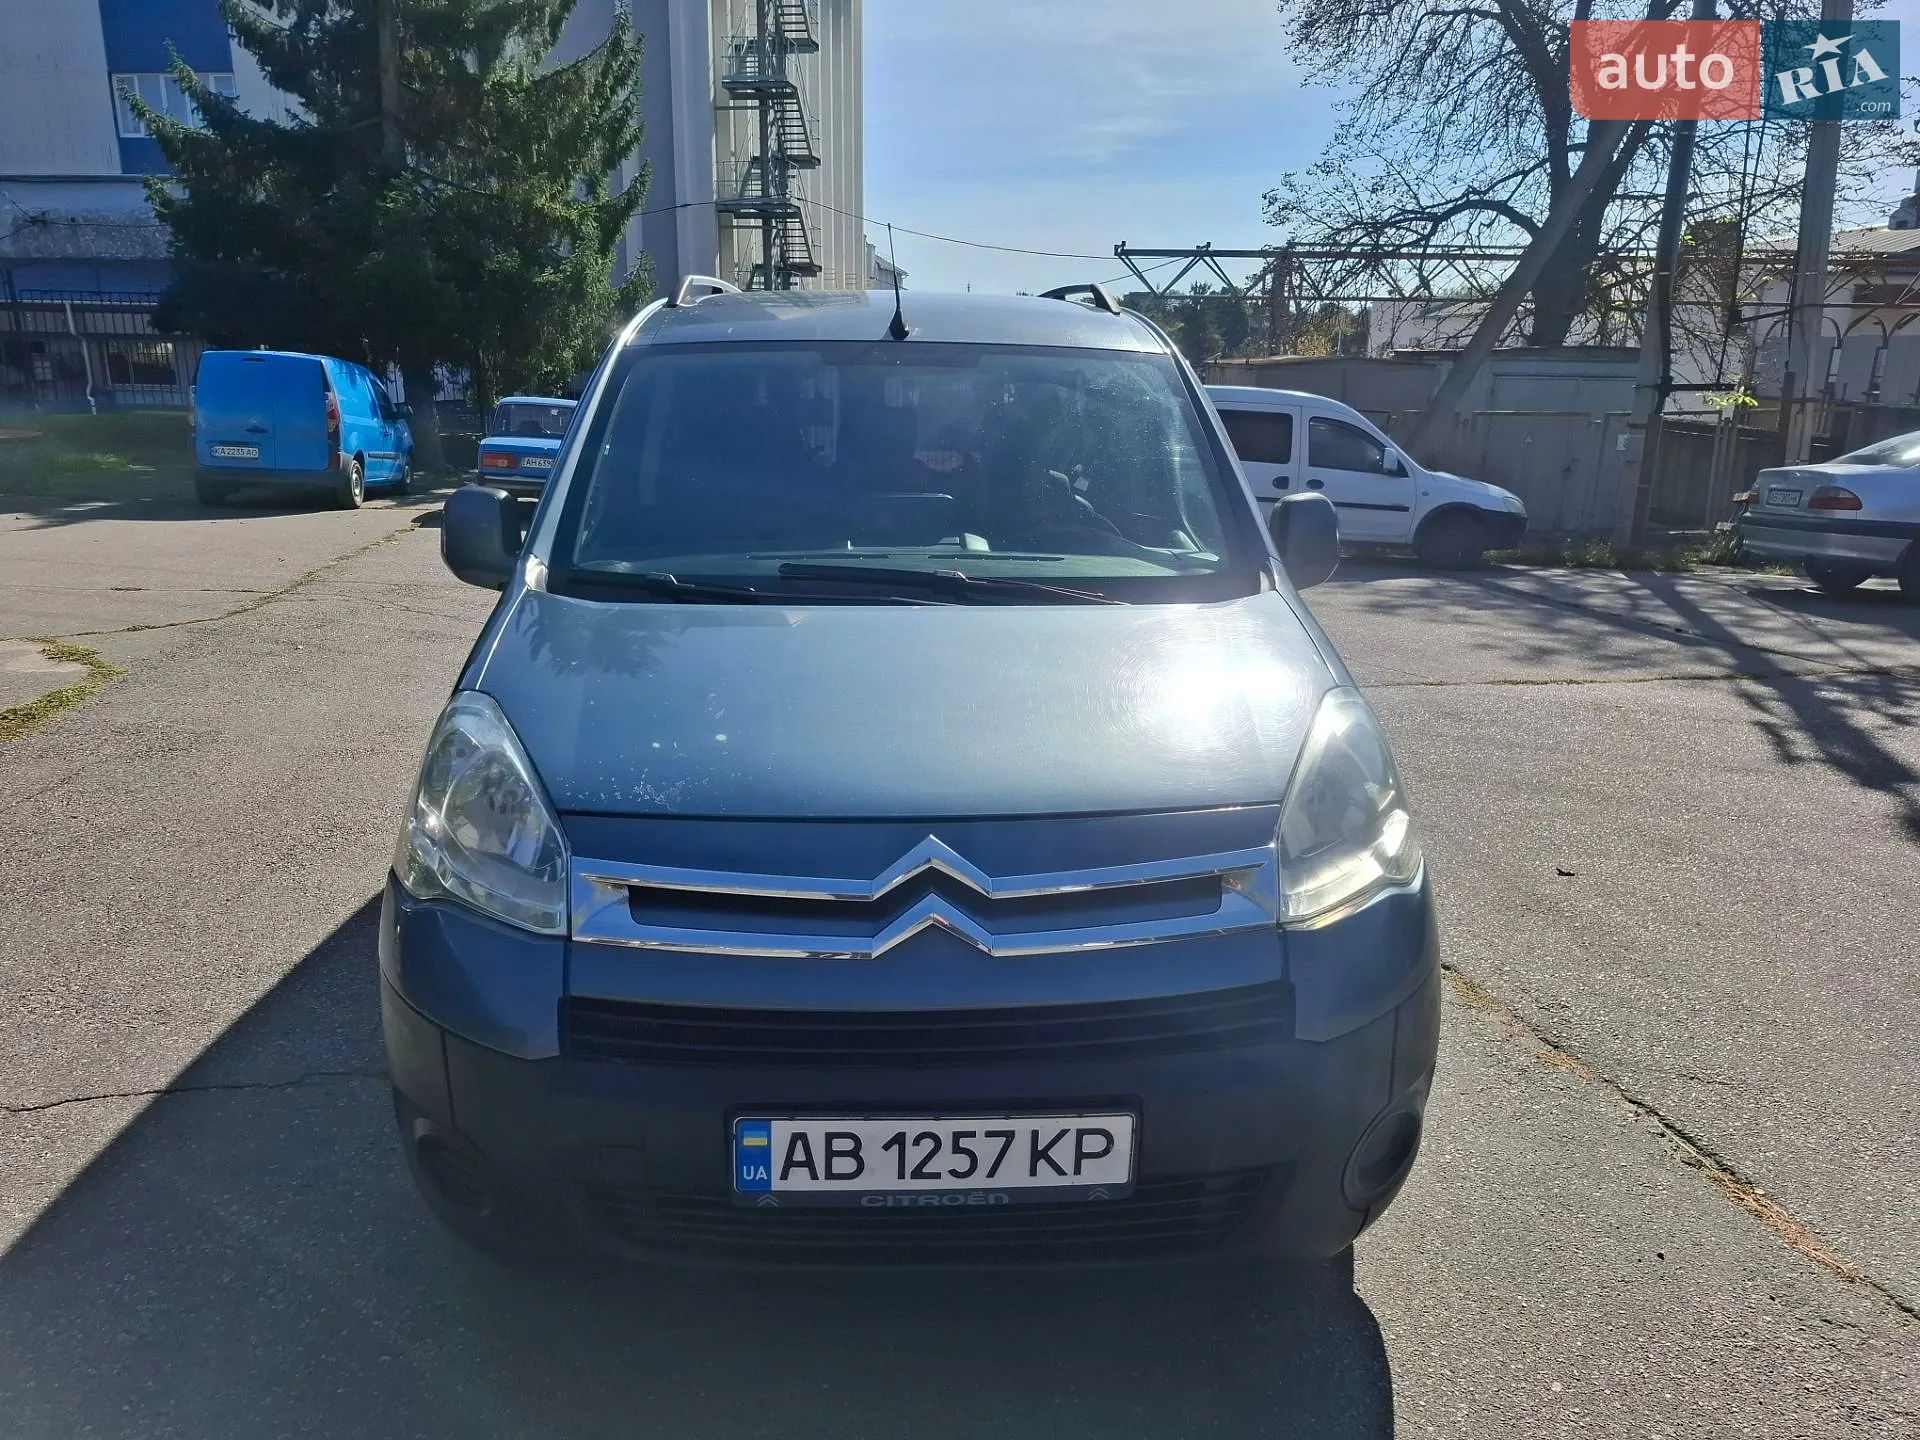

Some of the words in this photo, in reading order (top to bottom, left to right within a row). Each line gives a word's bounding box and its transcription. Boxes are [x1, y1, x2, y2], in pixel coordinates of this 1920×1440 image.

[778, 1131, 866, 1182] AB
[881, 1129, 1017, 1181] 1257
[1029, 1127, 1115, 1178] KP
[743, 1165, 768, 1181] UA
